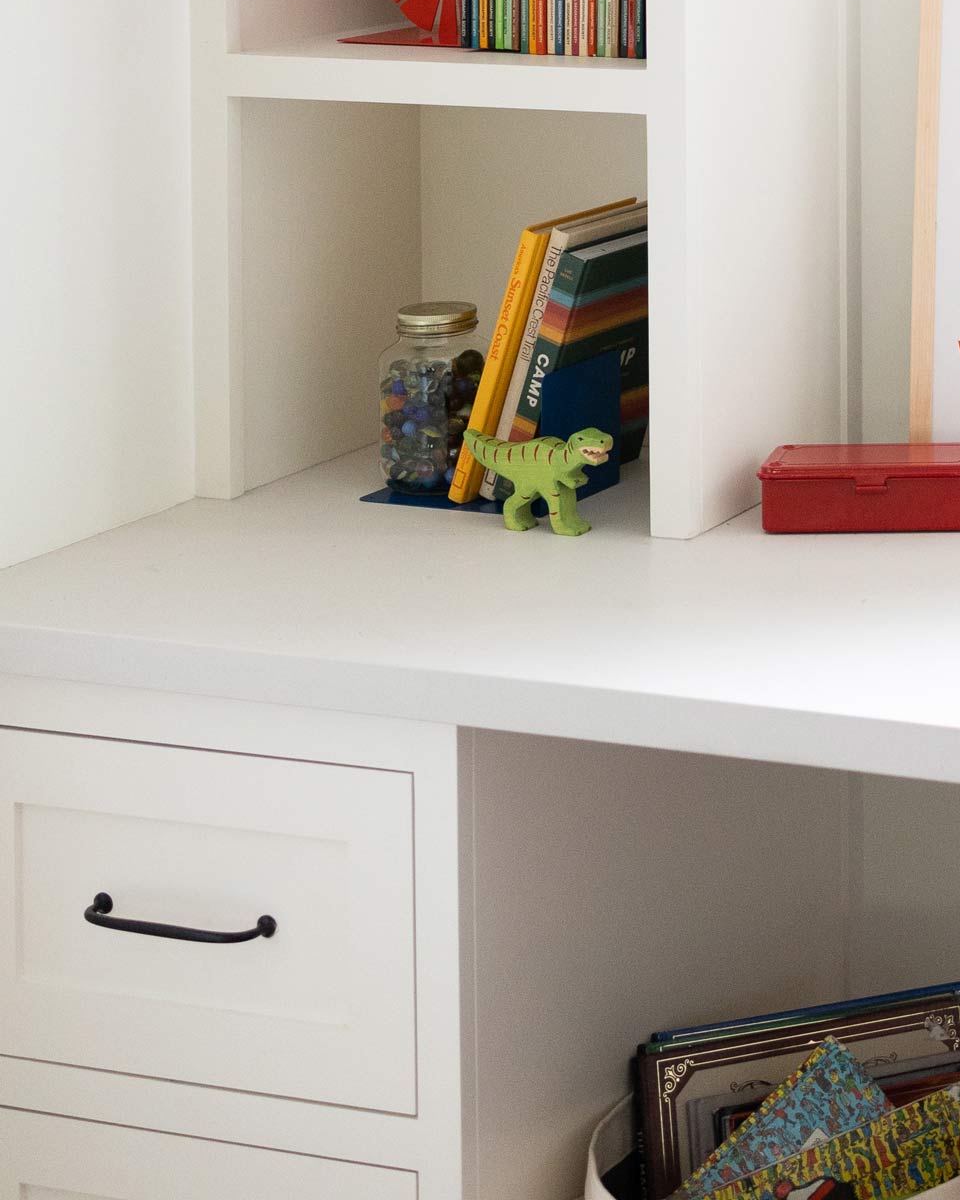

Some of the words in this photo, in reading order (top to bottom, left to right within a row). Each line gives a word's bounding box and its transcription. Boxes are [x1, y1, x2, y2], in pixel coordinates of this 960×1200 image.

[546, 246, 562, 267] The
[500, 278, 521, 324] Sunset
[535, 268, 555, 311] Pacific
[490, 324, 508, 361] Coast
[527, 311, 544, 340] Crest
[521, 339, 536, 362] Trail
[527, 353, 550, 408] CAMP
